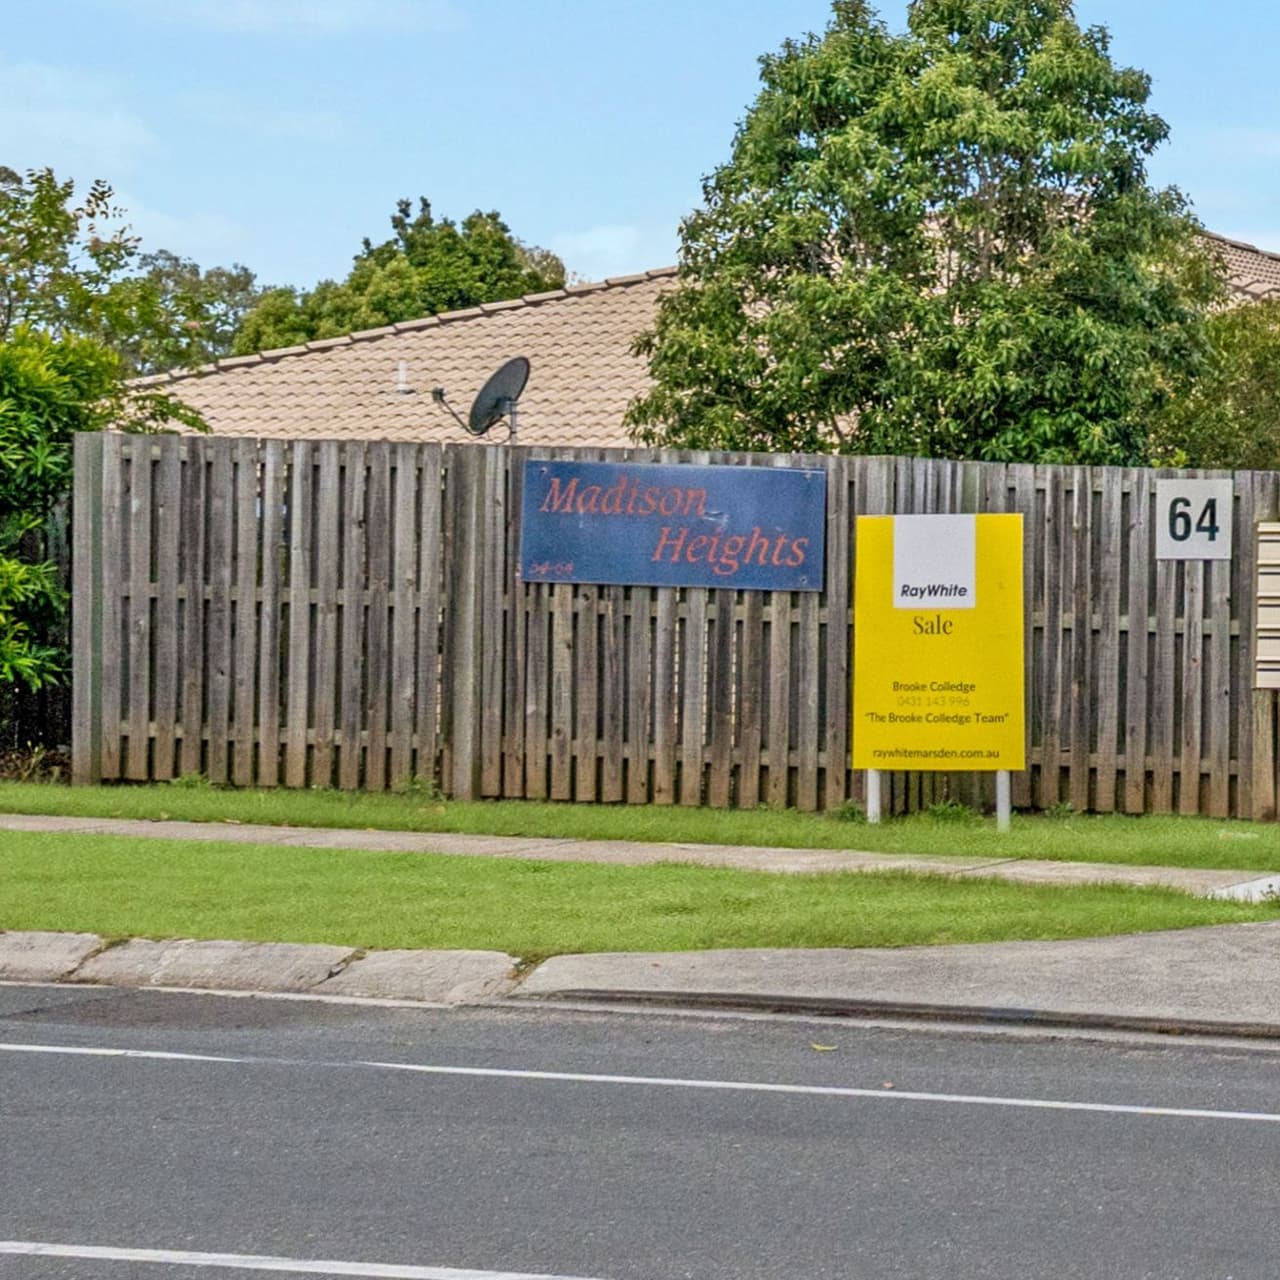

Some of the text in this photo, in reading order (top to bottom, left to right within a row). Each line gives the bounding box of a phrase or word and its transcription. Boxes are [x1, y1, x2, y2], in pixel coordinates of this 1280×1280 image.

[539, 473, 707, 518] Madison
[1166, 495, 1220, 542] 64
[652, 526, 810, 577] Heights
[900, 583, 969, 599] RayWhite
[912, 614, 954, 636] Sale
[892, 681, 928, 692] Brooke
[888, 712, 924, 723] Brooke
[872, 749, 1000, 760] raywhitemarsden.com.au
